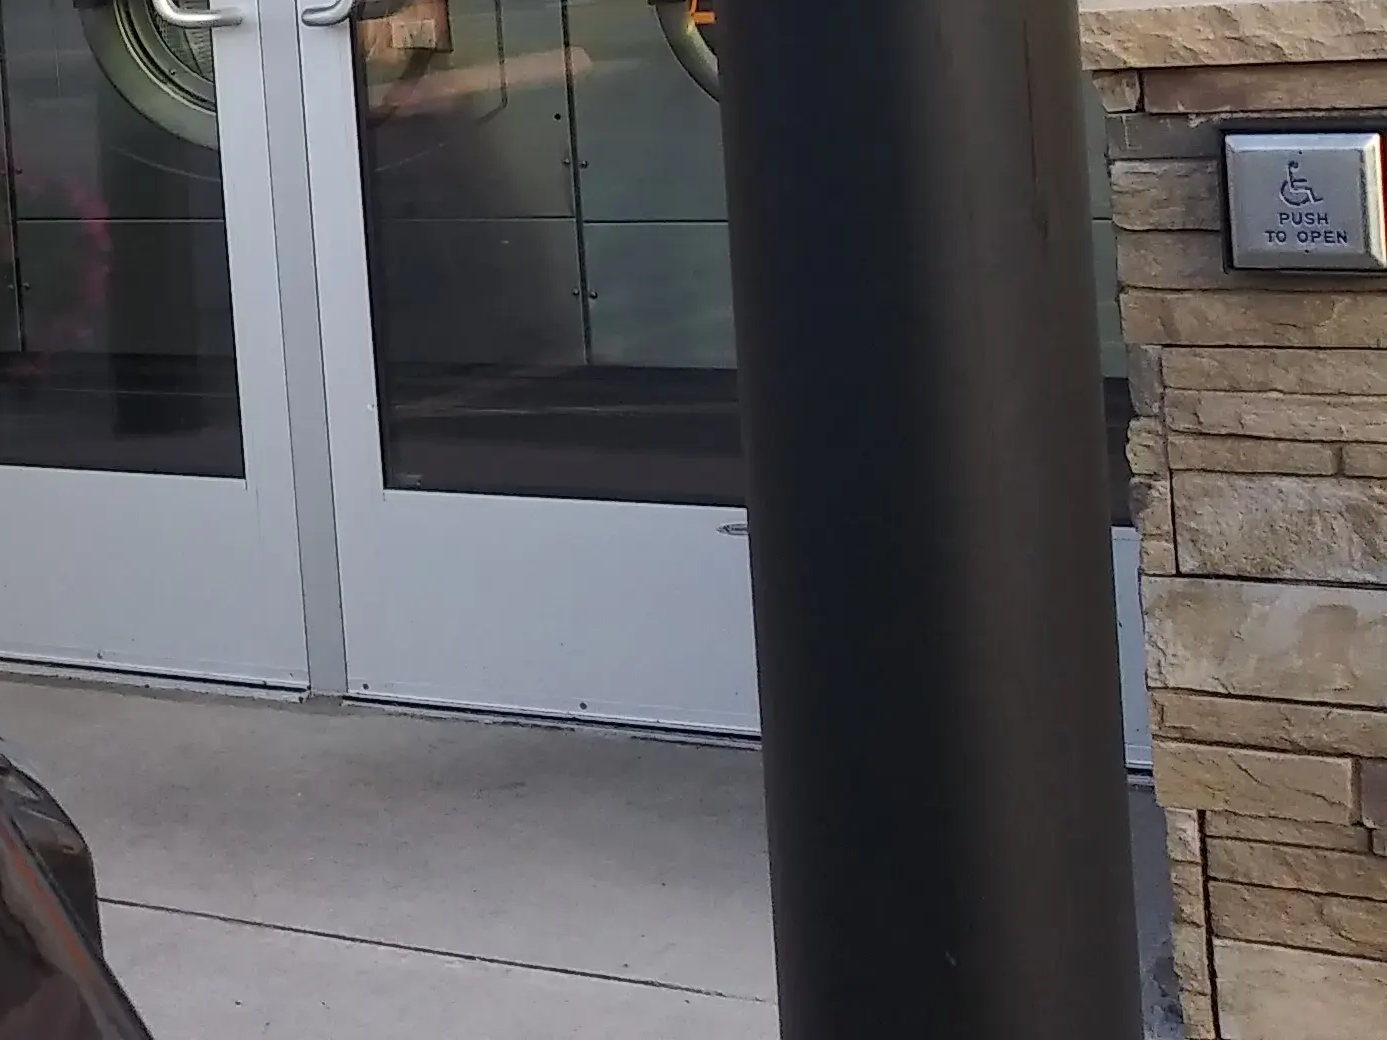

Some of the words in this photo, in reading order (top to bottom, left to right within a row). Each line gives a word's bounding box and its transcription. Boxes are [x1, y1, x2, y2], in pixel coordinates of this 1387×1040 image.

[1278, 212, 1329, 226] PUSH
[1264, 230, 1287, 244] TO
[1296, 230, 1349, 245] OPEN
